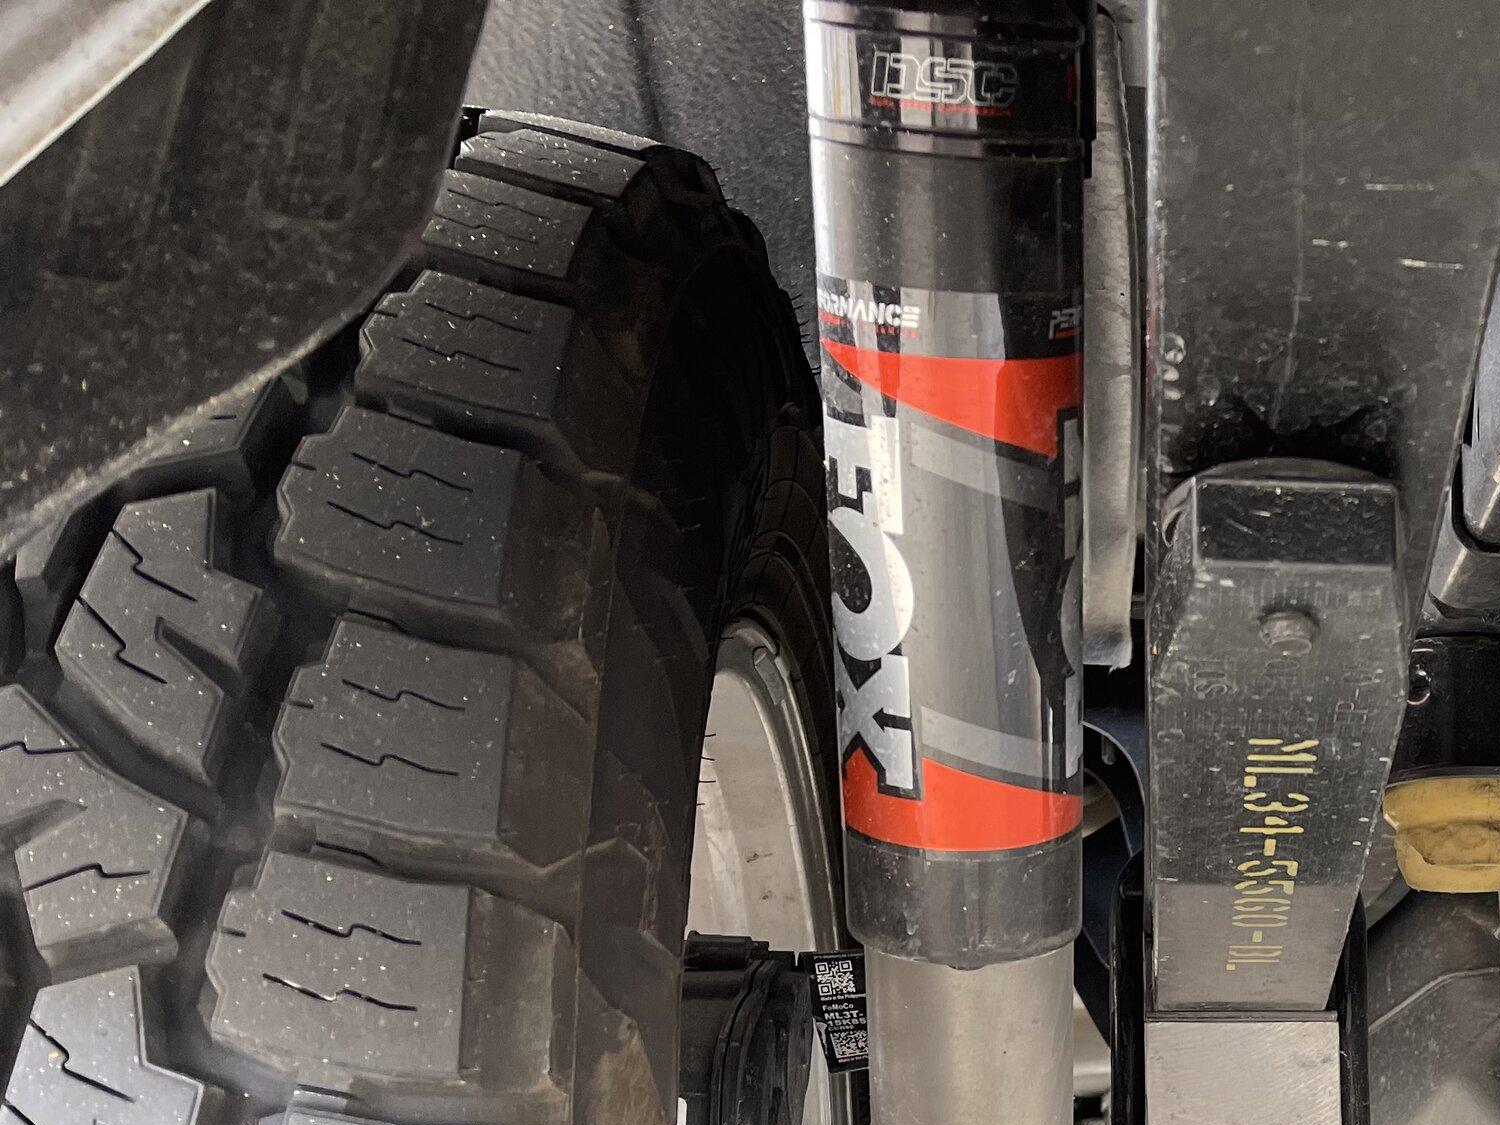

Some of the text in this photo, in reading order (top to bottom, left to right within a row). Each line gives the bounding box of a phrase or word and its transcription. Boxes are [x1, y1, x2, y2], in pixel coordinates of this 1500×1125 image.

[871, 51, 1018, 107] DSC
[823, 403, 914, 790] FOX
[822, 1003, 854, 1012] FoMoCo
[824, 1010, 864, 1020] ML3T-
